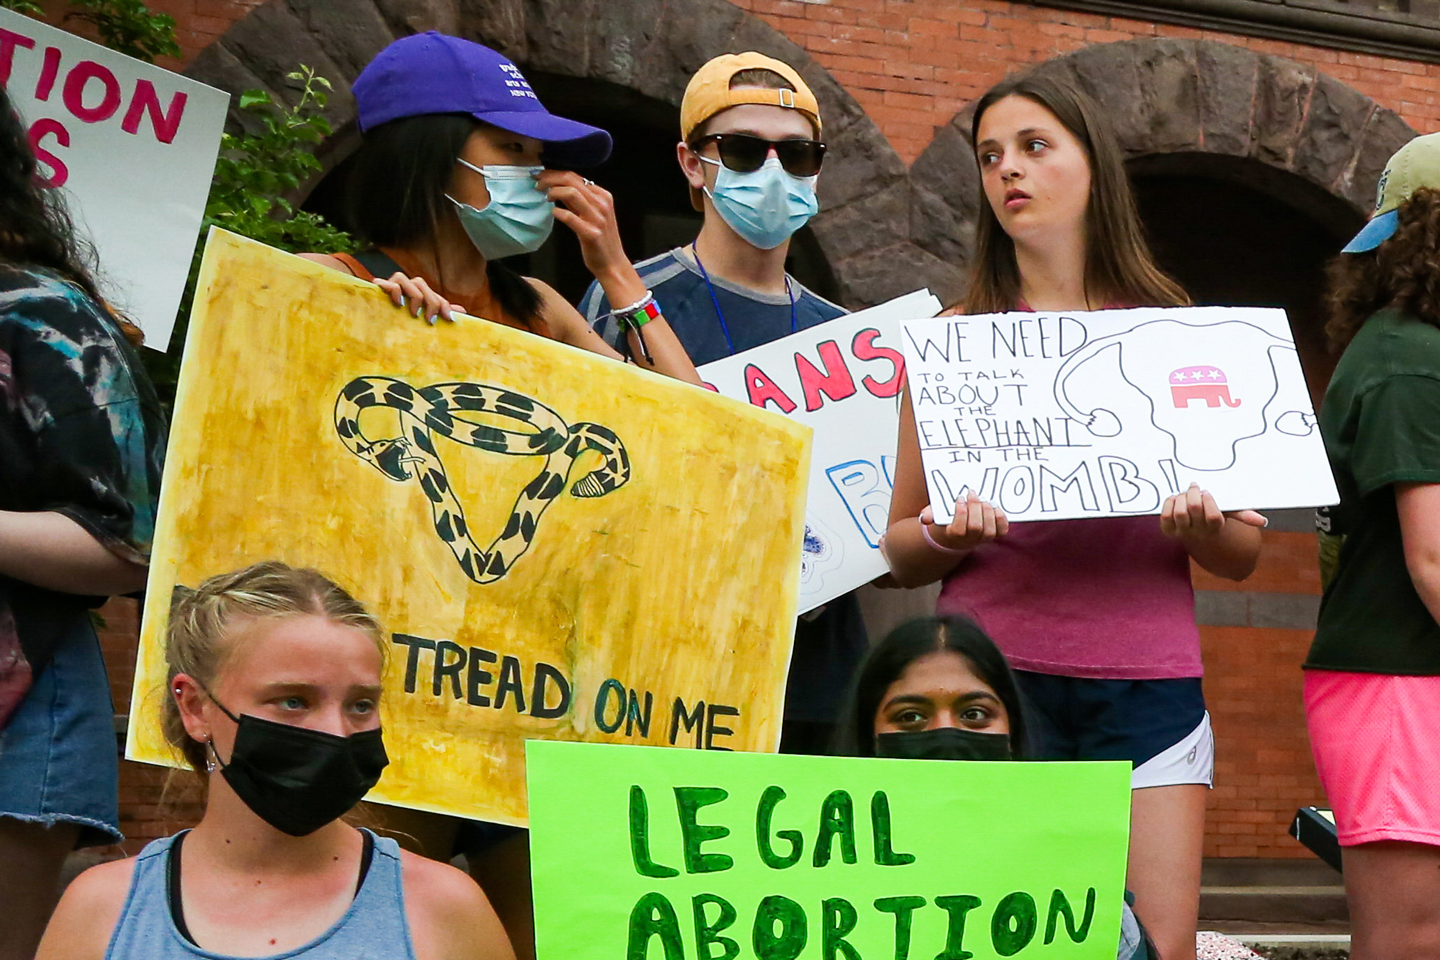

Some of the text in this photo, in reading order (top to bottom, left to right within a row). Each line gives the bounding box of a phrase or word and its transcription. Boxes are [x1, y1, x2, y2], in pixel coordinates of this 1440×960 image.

[904, 317, 1087, 363] WE NEED
[703, 328, 904, 414] ANS
[917, 369, 1025, 383] TO TALK
[918, 384, 1028, 406] ABOUT
[954, 405, 997, 416] THE
[919, 417, 1073, 447] ELEPHANT
[948, 447, 1049, 463] IN THE
[392, 633, 741, 751] TREAD ON ME
[628, 784, 916, 878] LEGAL
